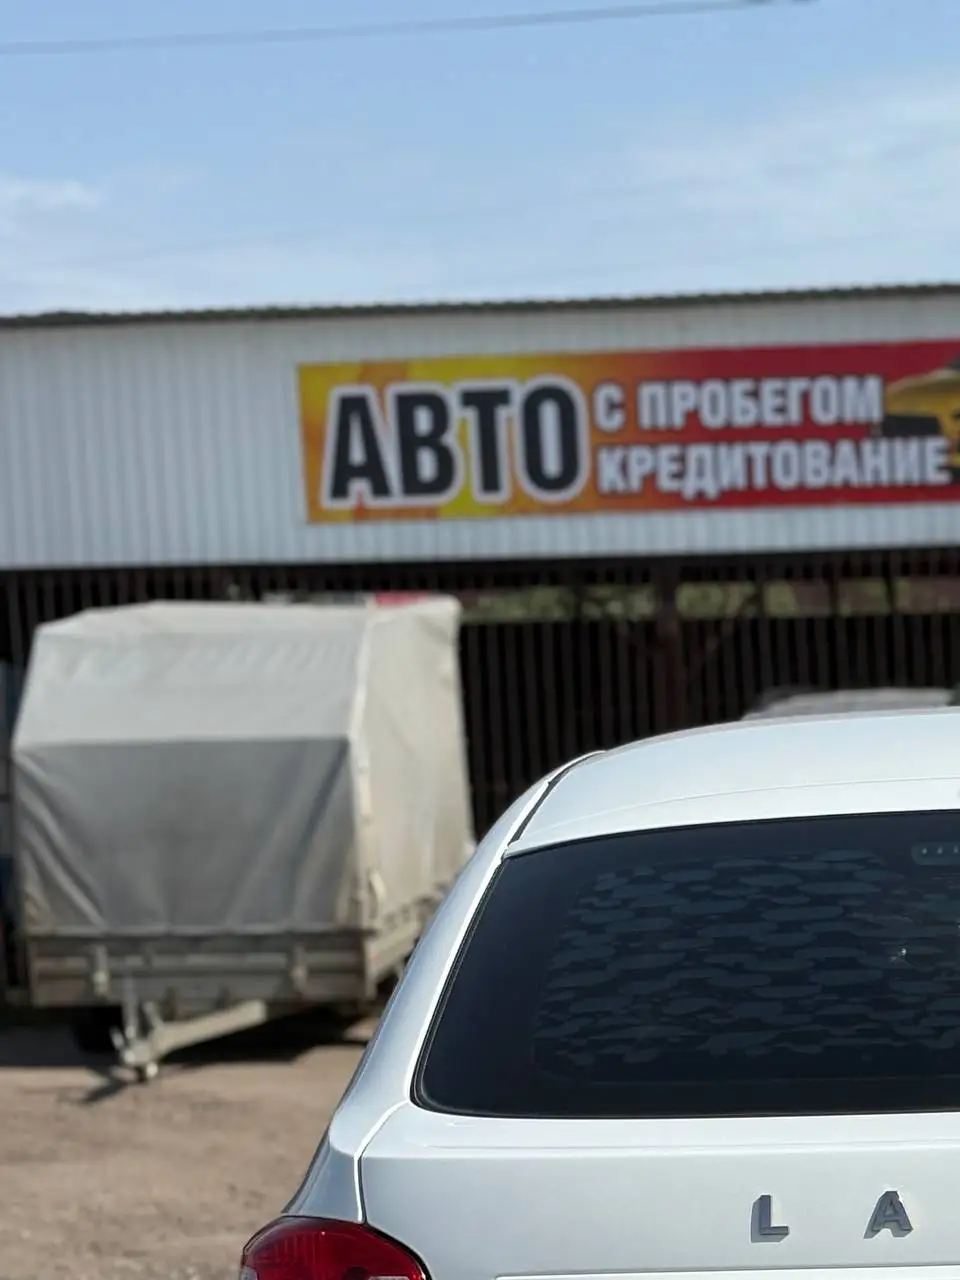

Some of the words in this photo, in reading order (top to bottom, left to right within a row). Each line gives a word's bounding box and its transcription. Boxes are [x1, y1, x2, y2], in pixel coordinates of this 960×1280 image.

[594, 381, 626, 430] С
[638, 375, 882, 427] ПРОБЕГОМ
[328, 384, 585, 501] АВТО
[599, 437, 952, 499] КРЕДИТОВАНИЕ
